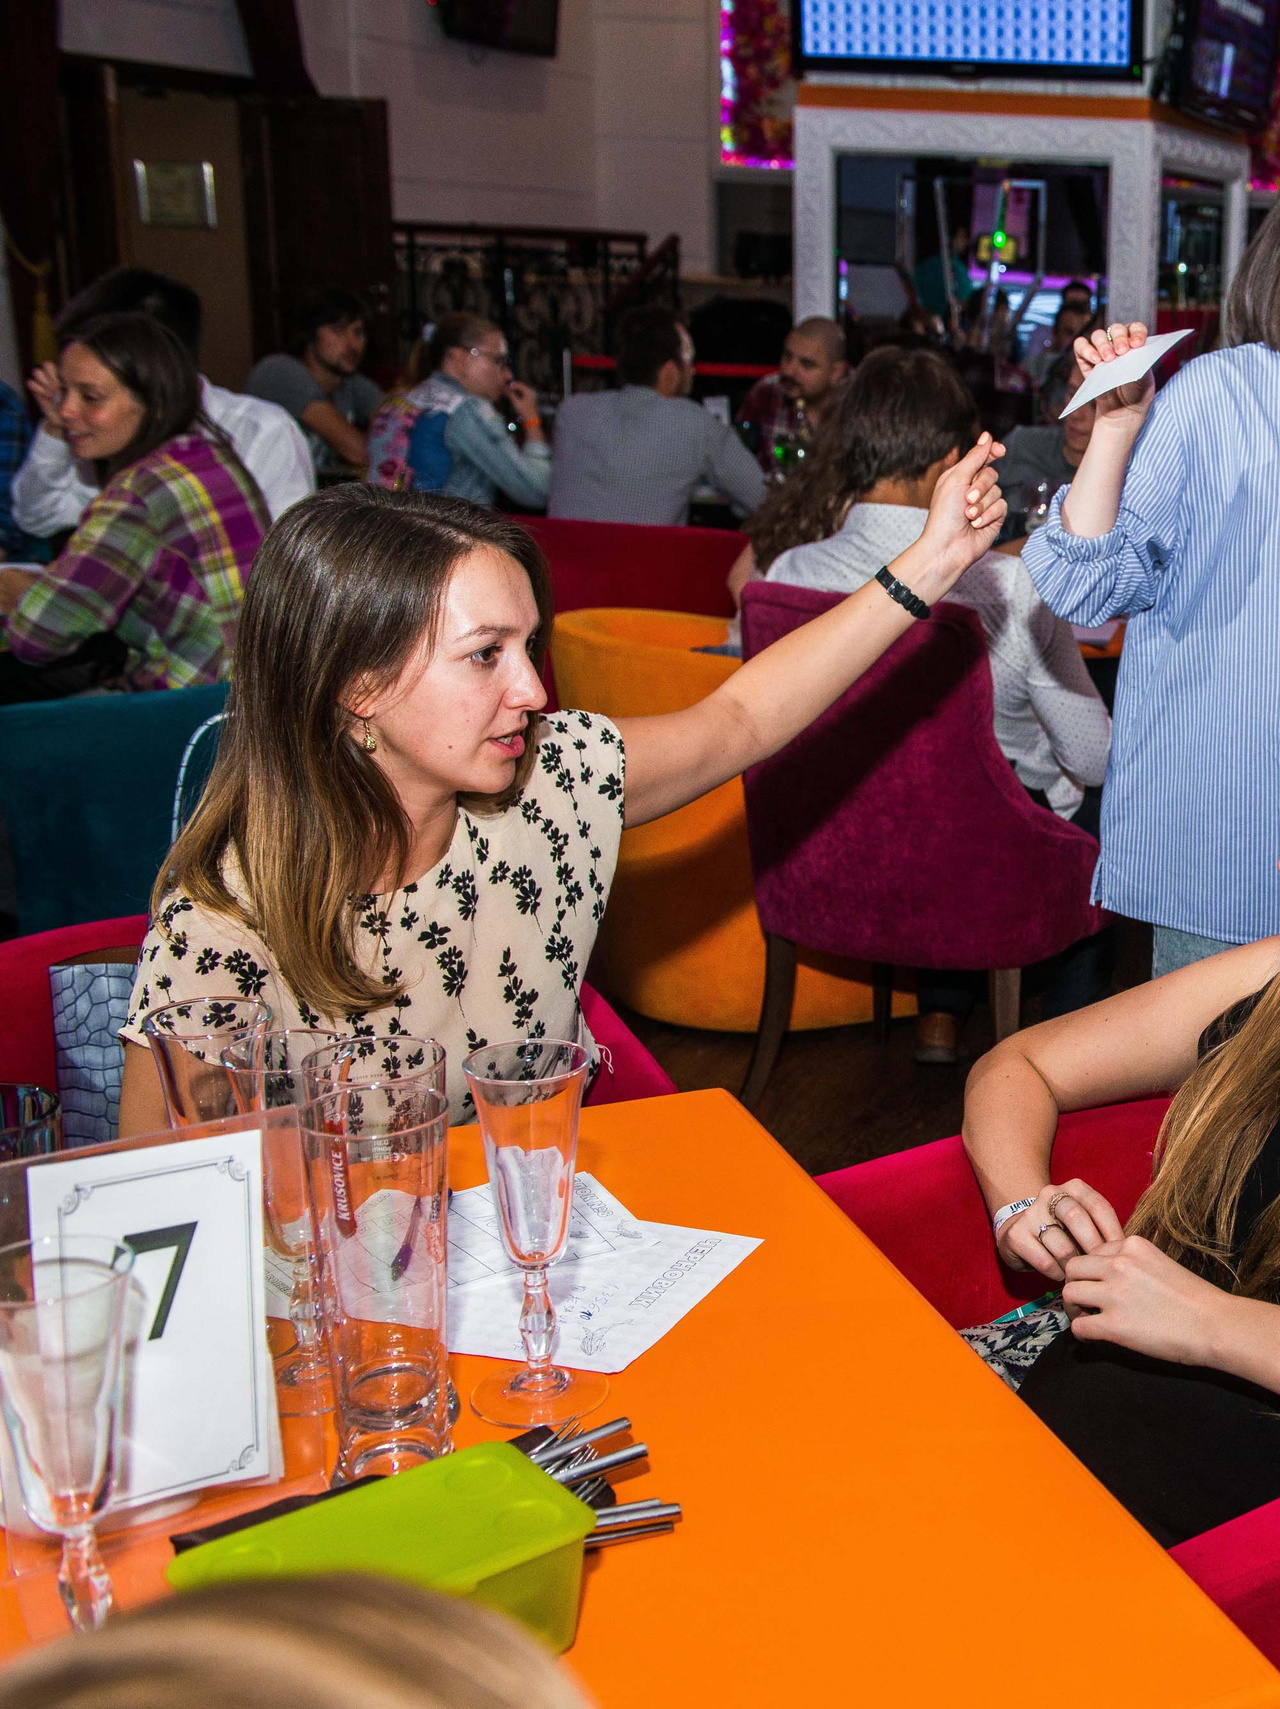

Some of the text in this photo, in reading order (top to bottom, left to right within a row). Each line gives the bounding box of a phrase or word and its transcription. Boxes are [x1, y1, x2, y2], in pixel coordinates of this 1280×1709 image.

[331, 1149, 352, 1222] KRUSOVICE
[110, 1220, 199, 1342] 7
[628, 1236, 723, 1309] ЧЕРНОВИК
